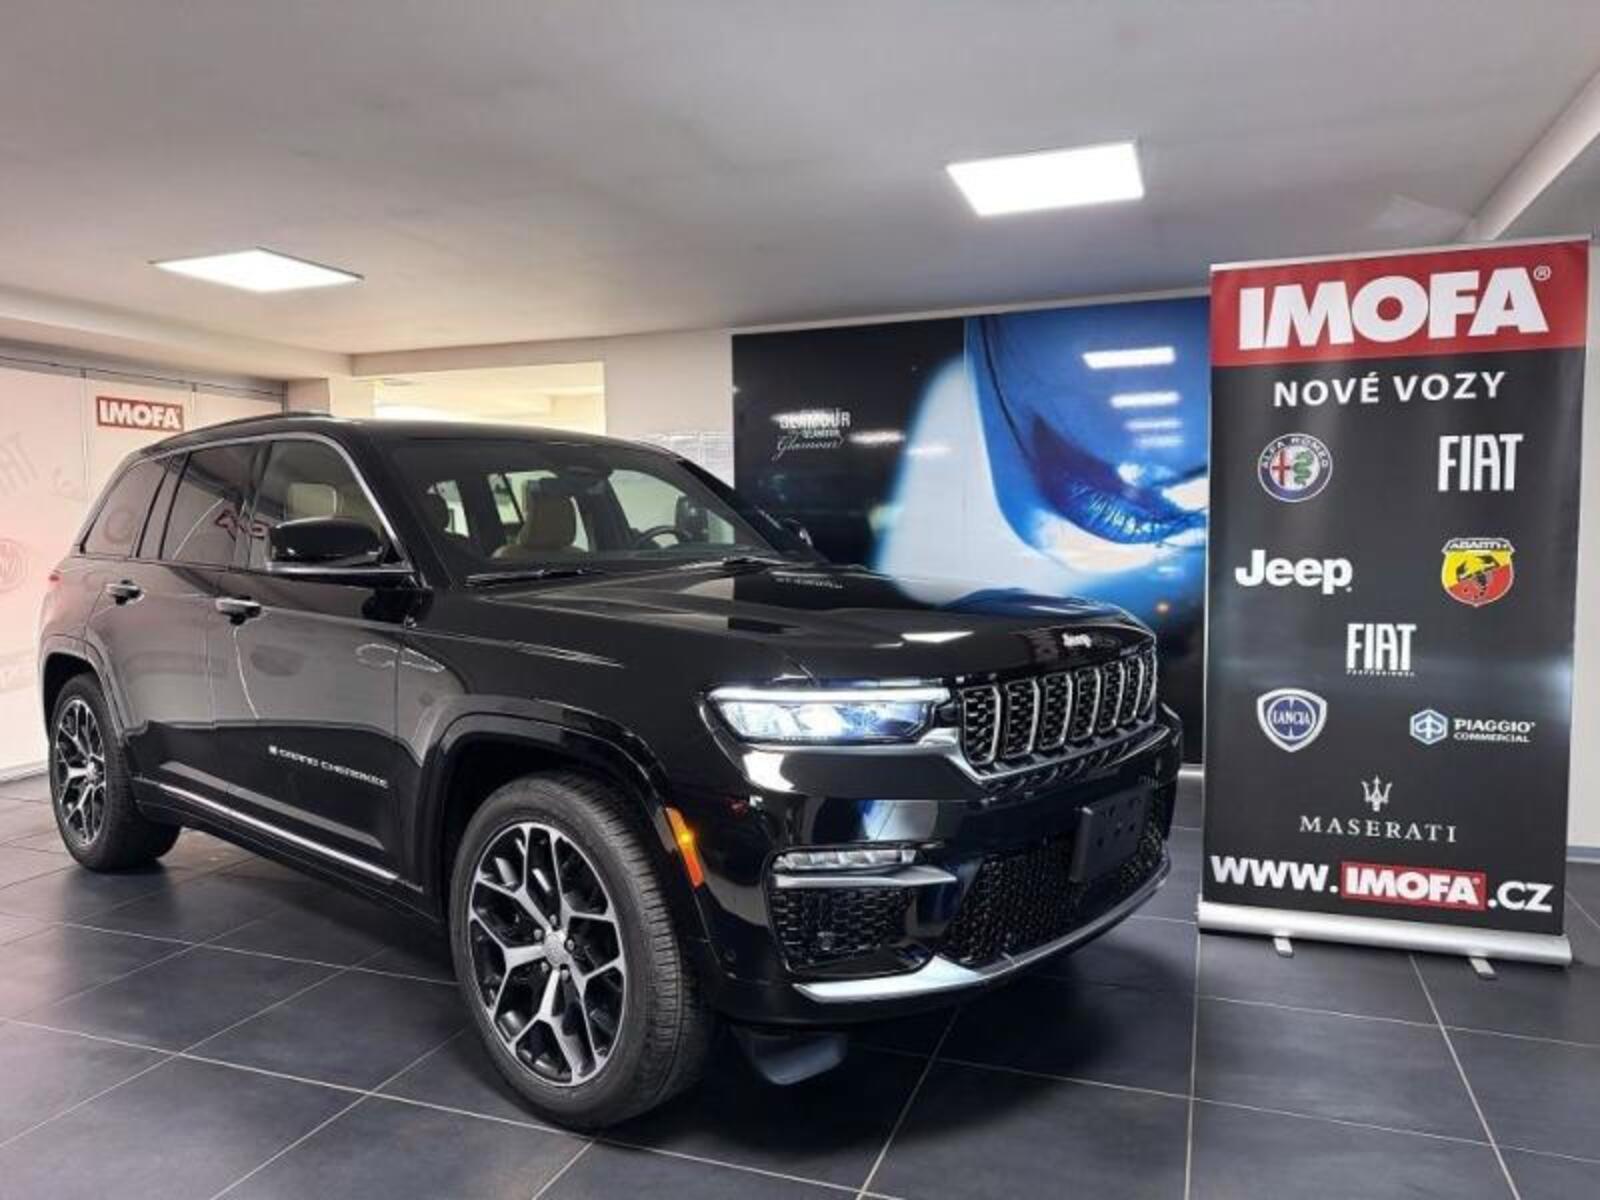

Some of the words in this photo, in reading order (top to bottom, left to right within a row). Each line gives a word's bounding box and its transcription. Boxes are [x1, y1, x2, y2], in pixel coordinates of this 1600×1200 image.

[1273, 371, 1380, 407] NOVÉ
[1393, 371, 1507, 400] VOZY
[99, 399, 181, 430] IMOFA
[1438, 434, 1524, 492] FIAT
[1235, 549, 1353, 595] Jeep
[1346, 623, 1418, 671] FIAT
[1454, 718, 1532, 733] PIAGGIO
[1299, 815, 1457, 844] MASERATI
